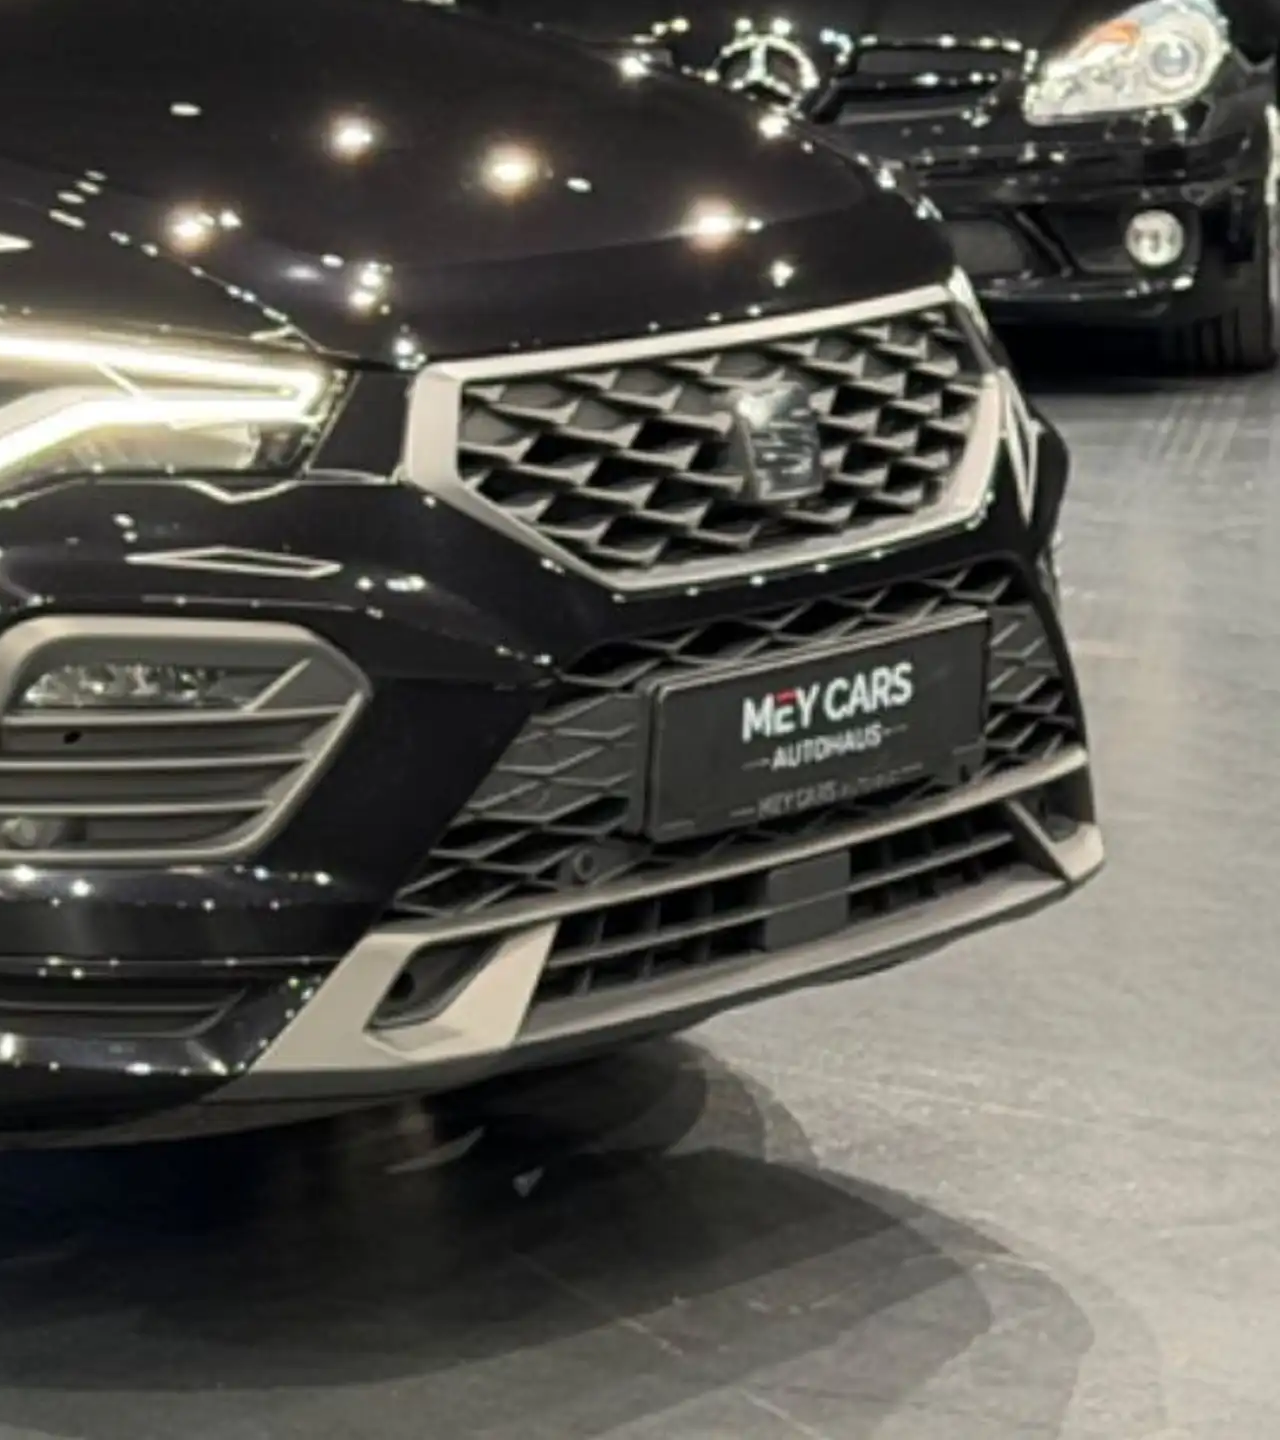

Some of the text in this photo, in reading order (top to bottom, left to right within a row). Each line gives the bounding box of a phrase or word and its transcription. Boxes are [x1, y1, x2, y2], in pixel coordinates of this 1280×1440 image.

[742, 661, 914, 743] MEY CARS
[771, 723, 883, 771] AUTOHAUS
